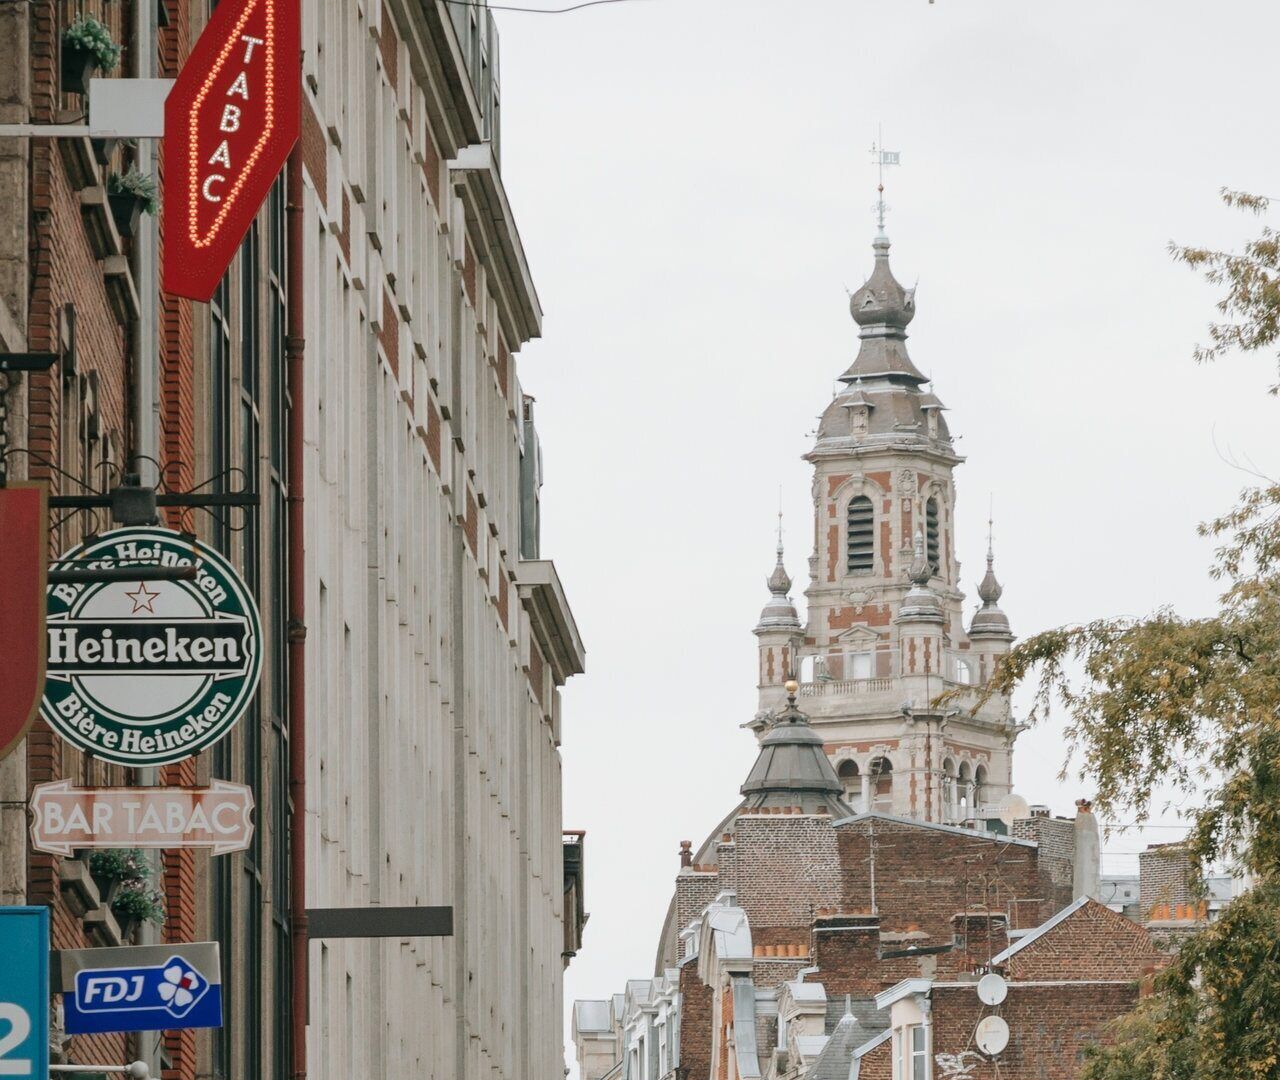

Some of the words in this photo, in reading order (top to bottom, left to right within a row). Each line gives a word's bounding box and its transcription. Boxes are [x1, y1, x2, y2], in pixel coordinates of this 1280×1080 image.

[202, 35, 263, 202] TABAC
[47, 627, 240, 664] Heineken
[55, 692, 118, 748] Bière
[120, 691, 231, 753] Heineken
[44, 802, 114, 834] BAR
[122, 801, 240, 834] TABAC
[84, 975, 145, 1004] FDJ
